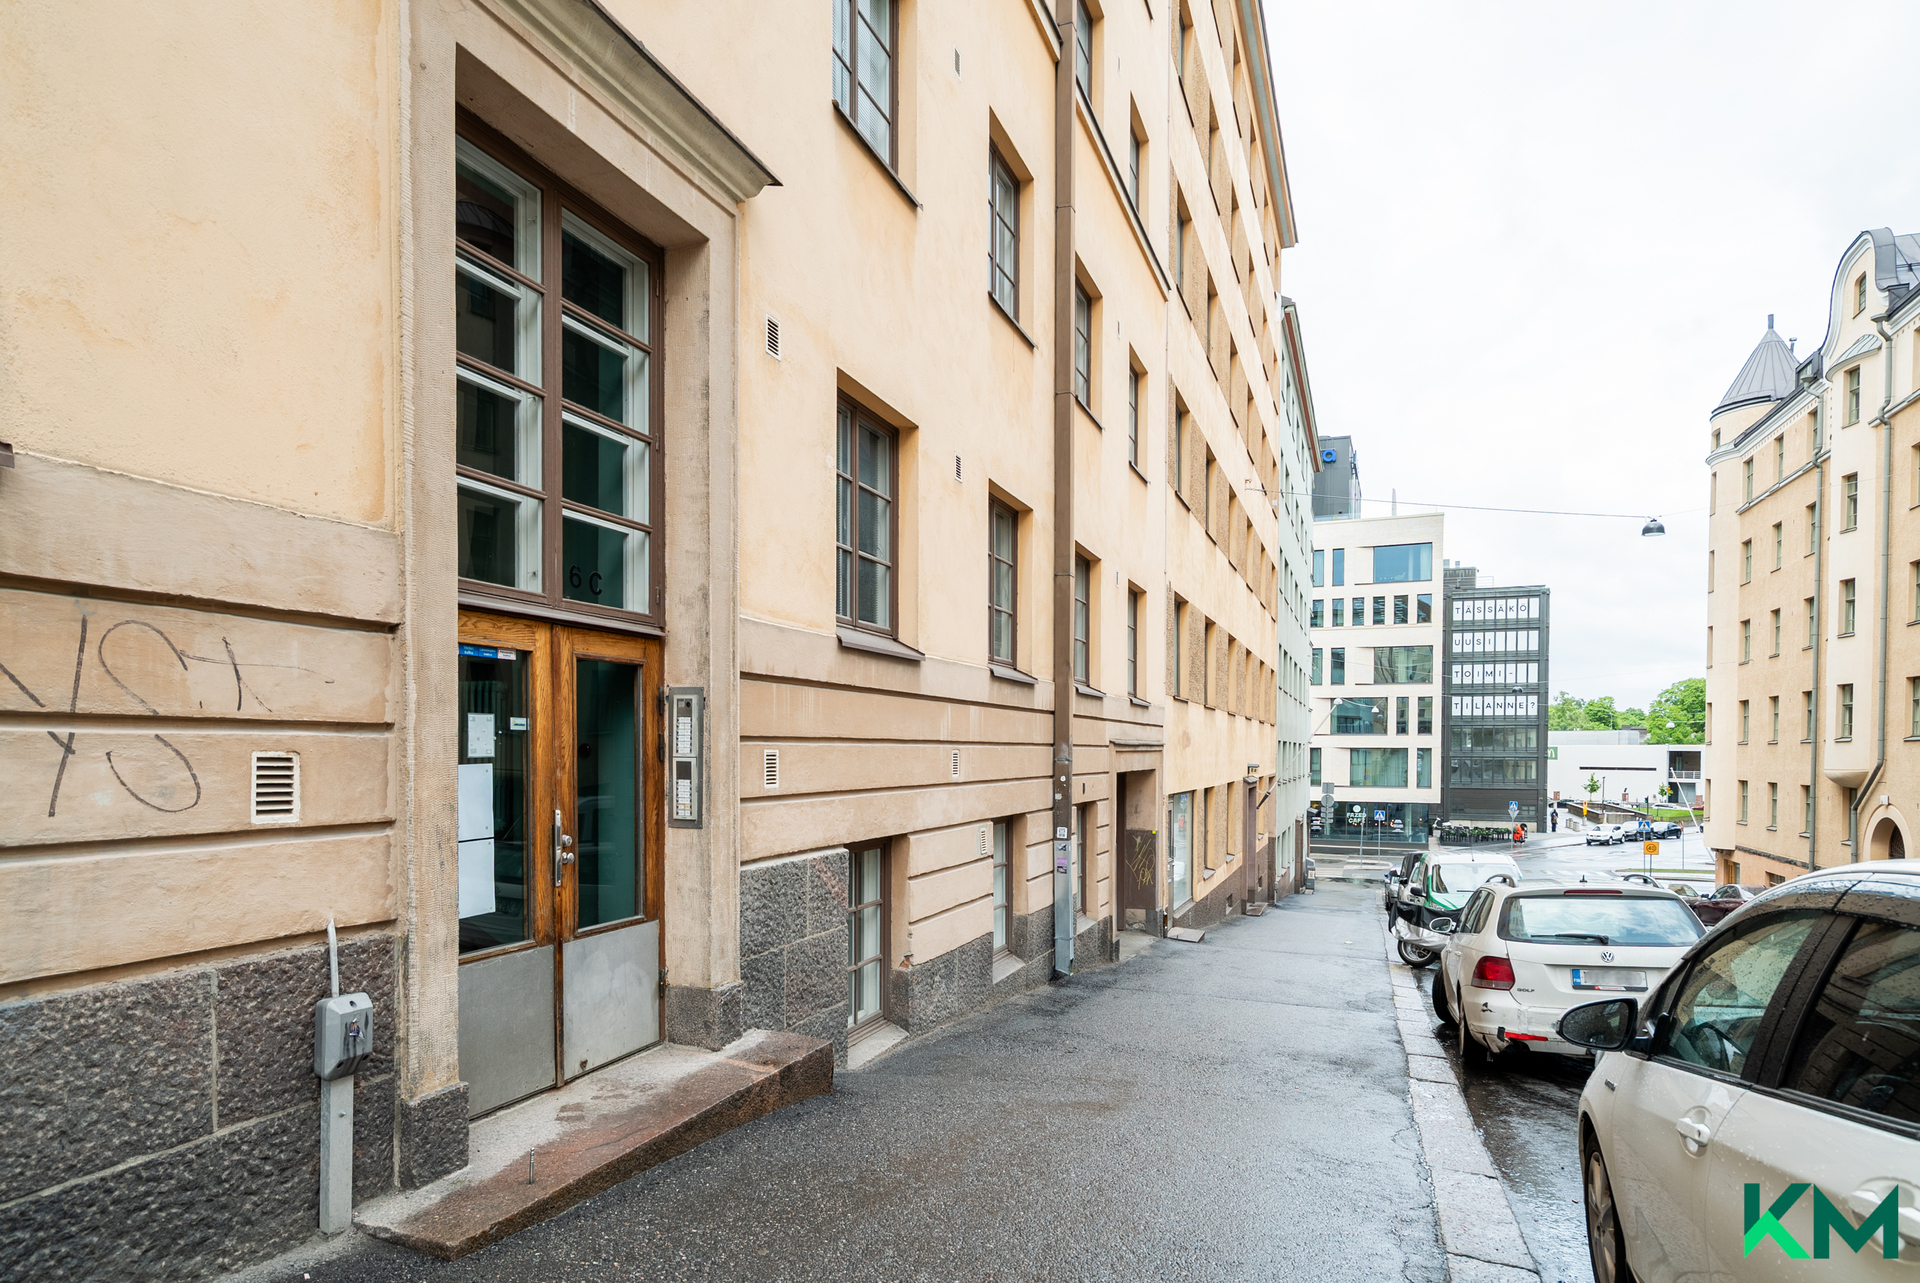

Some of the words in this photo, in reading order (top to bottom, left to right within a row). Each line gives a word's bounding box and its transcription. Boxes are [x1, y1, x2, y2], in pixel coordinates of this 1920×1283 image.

[569, 564, 582, 589] 6
[589, 571, 603, 596] C
[1455, 602, 1527, 615] TÄSSÄKÖ
[1454, 638, 1492, 646] UUSI
[1454, 670, 1513, 678] TOIMI-
[1454, 701, 1535, 710] TILANNE?
